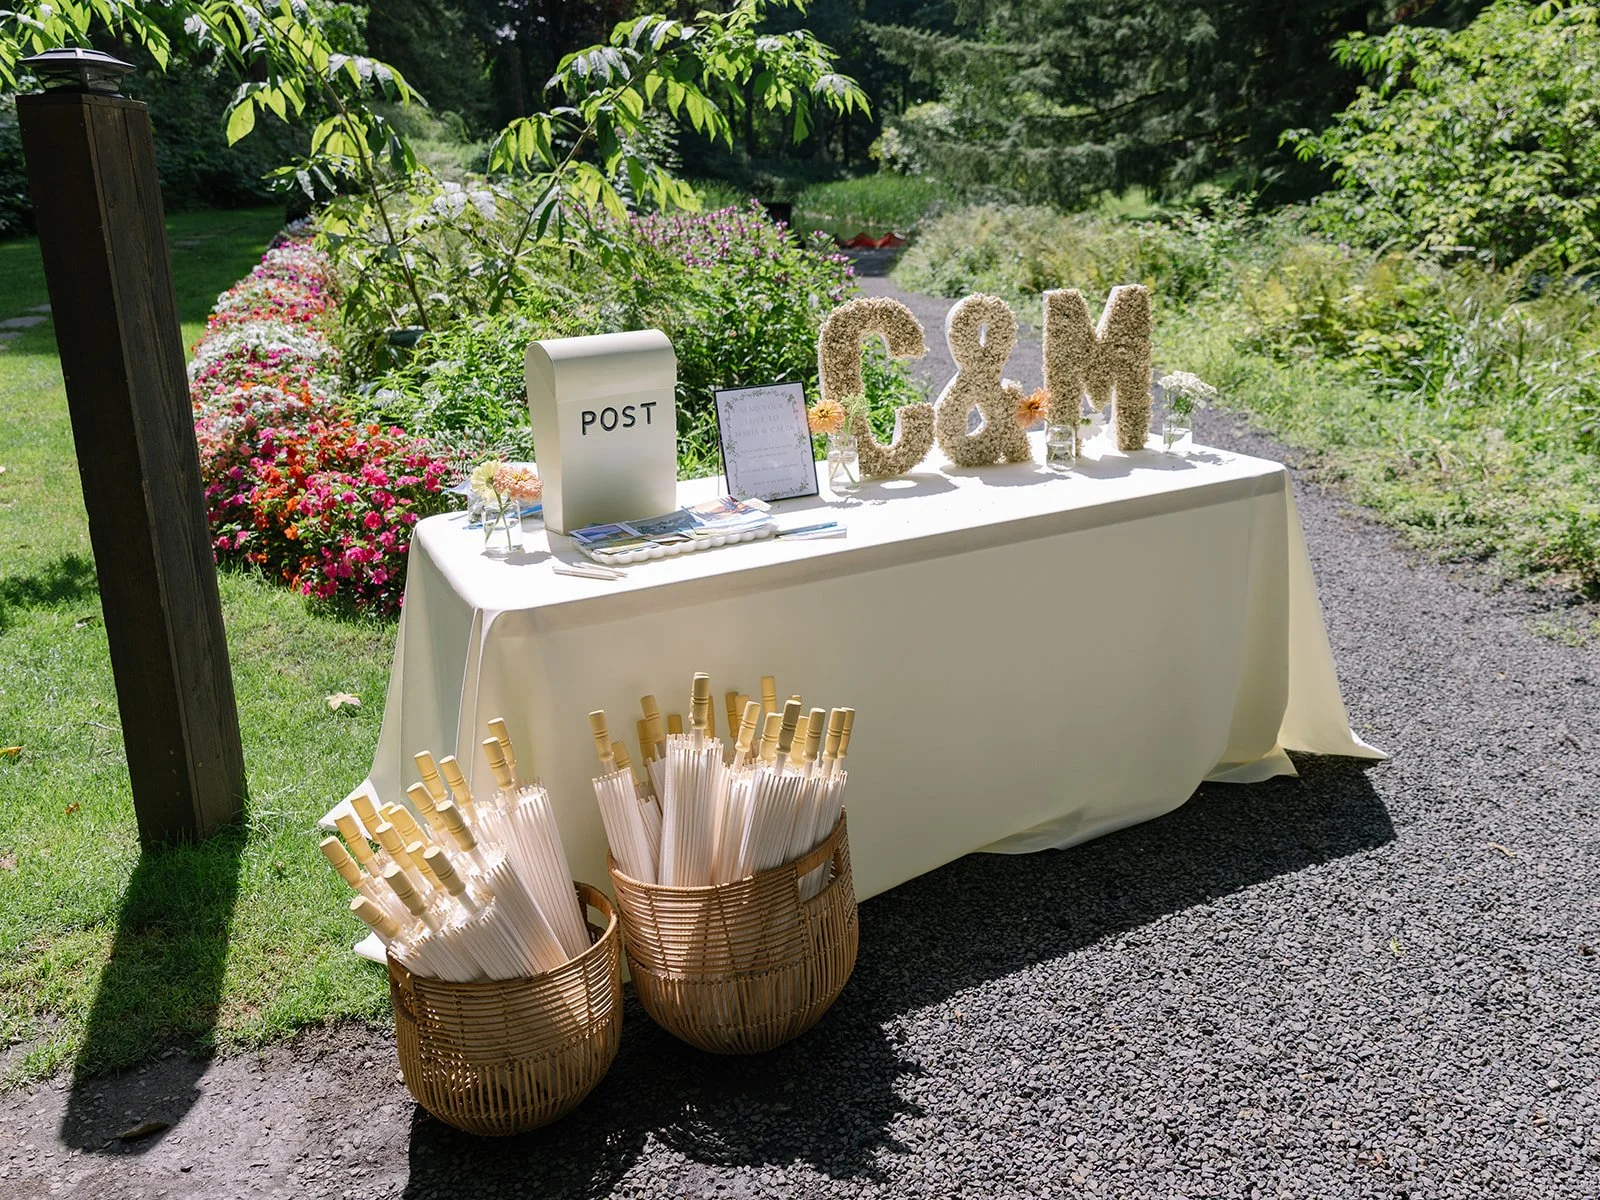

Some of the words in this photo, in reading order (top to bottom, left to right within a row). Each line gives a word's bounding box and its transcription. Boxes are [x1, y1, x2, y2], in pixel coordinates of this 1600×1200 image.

[762, 402, 784, 410] YOUR
[581, 401, 657, 436] POST
[745, 416, 764, 424] LOVE
